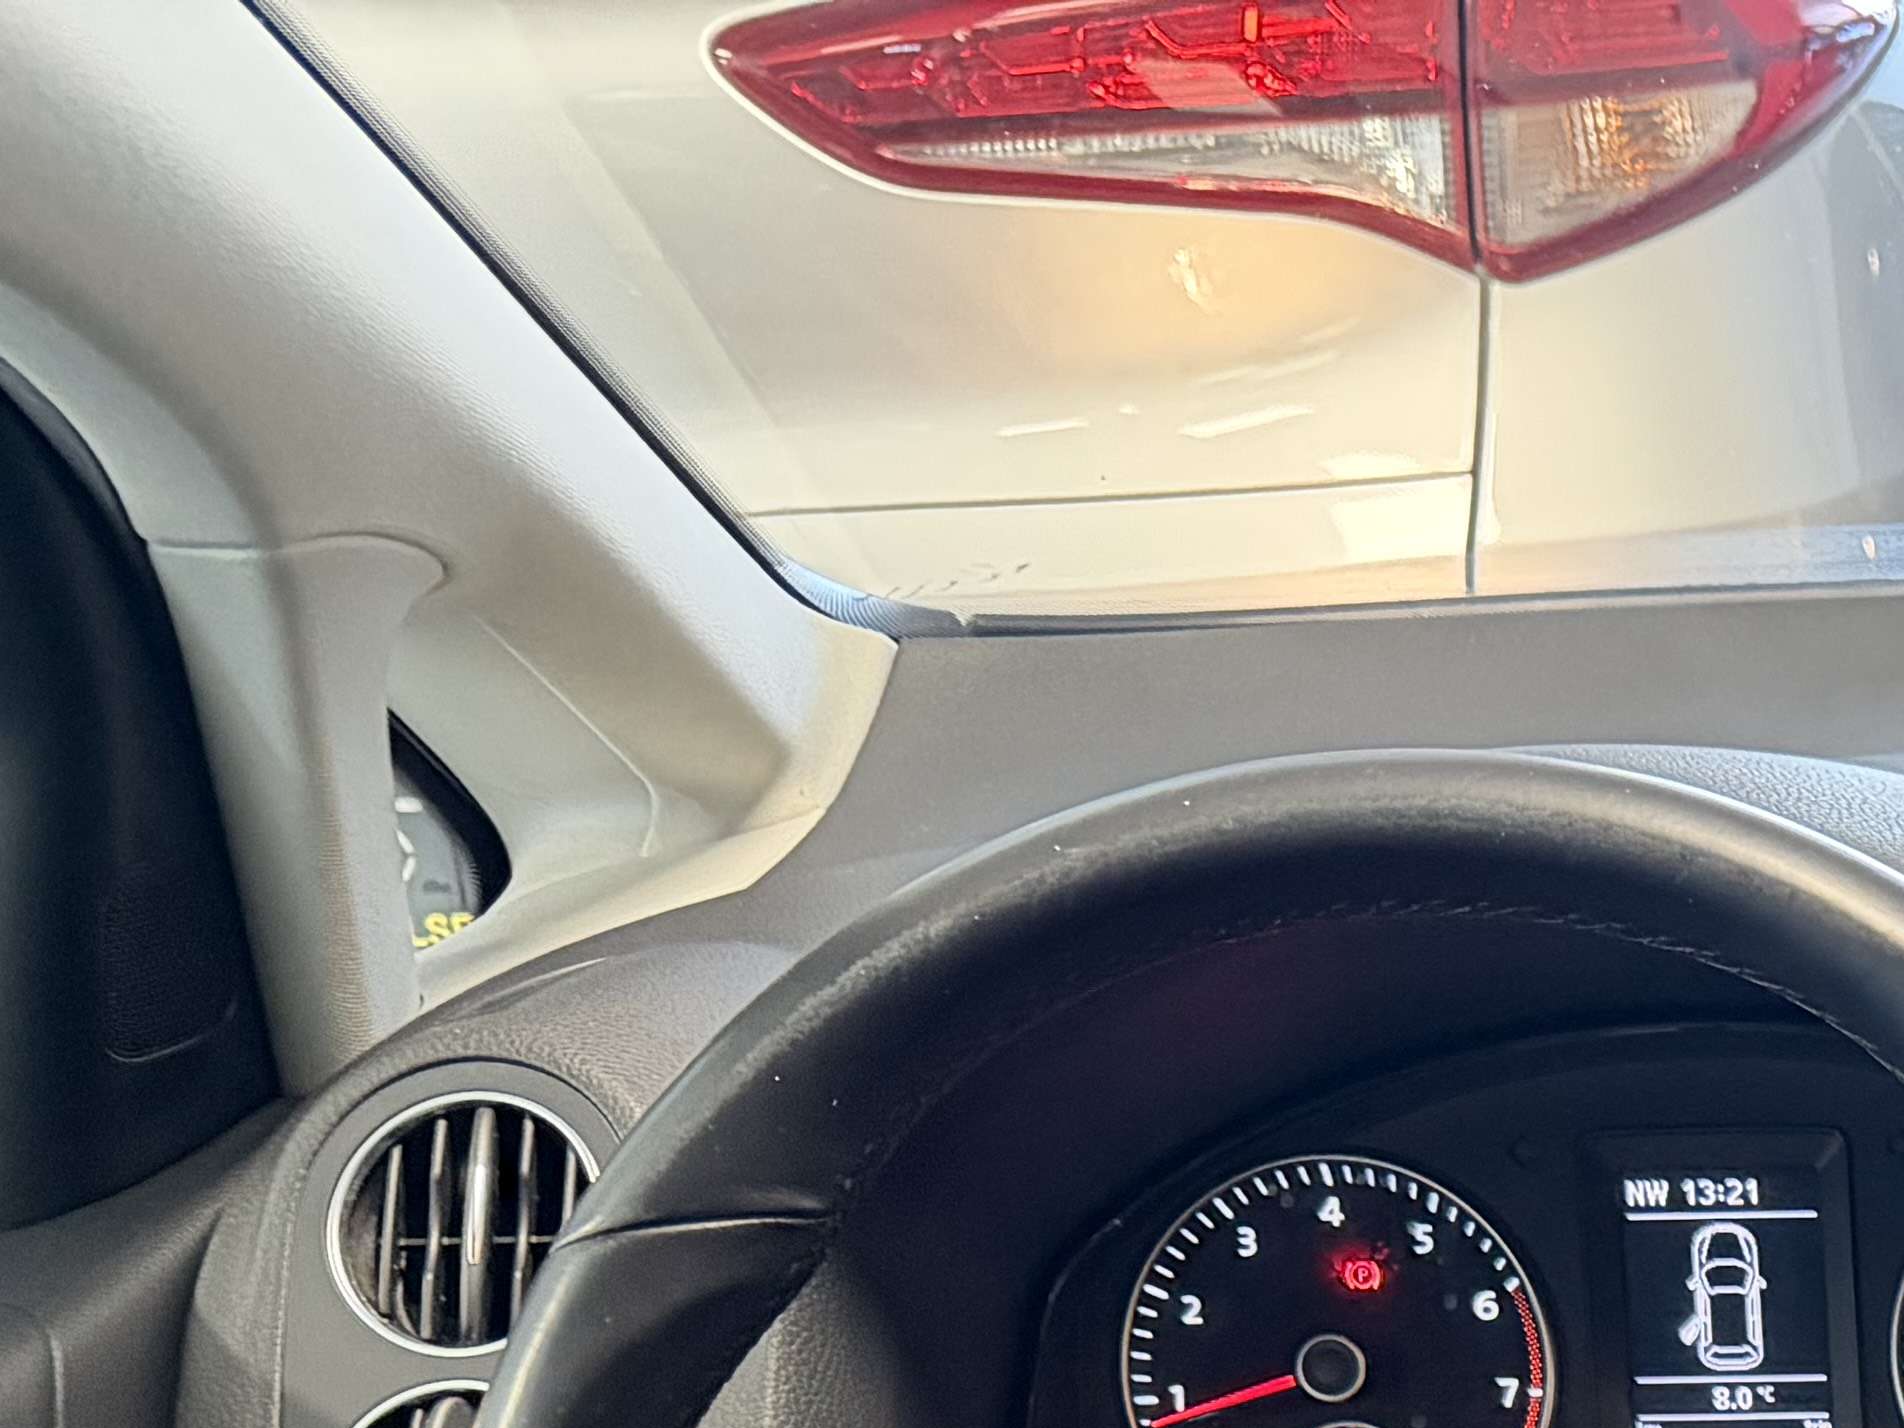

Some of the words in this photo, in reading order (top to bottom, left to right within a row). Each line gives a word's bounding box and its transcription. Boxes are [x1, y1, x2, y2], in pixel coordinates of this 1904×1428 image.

[1623, 1178, 1670, 1208] NW
[1681, 1177, 1759, 1207] 13:21
[1316, 1195, 1345, 1228] 4
[1236, 1226, 1258, 1257] 3
[1406, 1221, 1435, 1256] 5
[1180, 1294, 1204, 1326] 2
[1471, 1289, 1500, 1321] 6
[1167, 1384, 1186, 1412] 1
[1493, 1376, 1520, 1408] 7
[1711, 1385, 1754, 1411] 8.0
